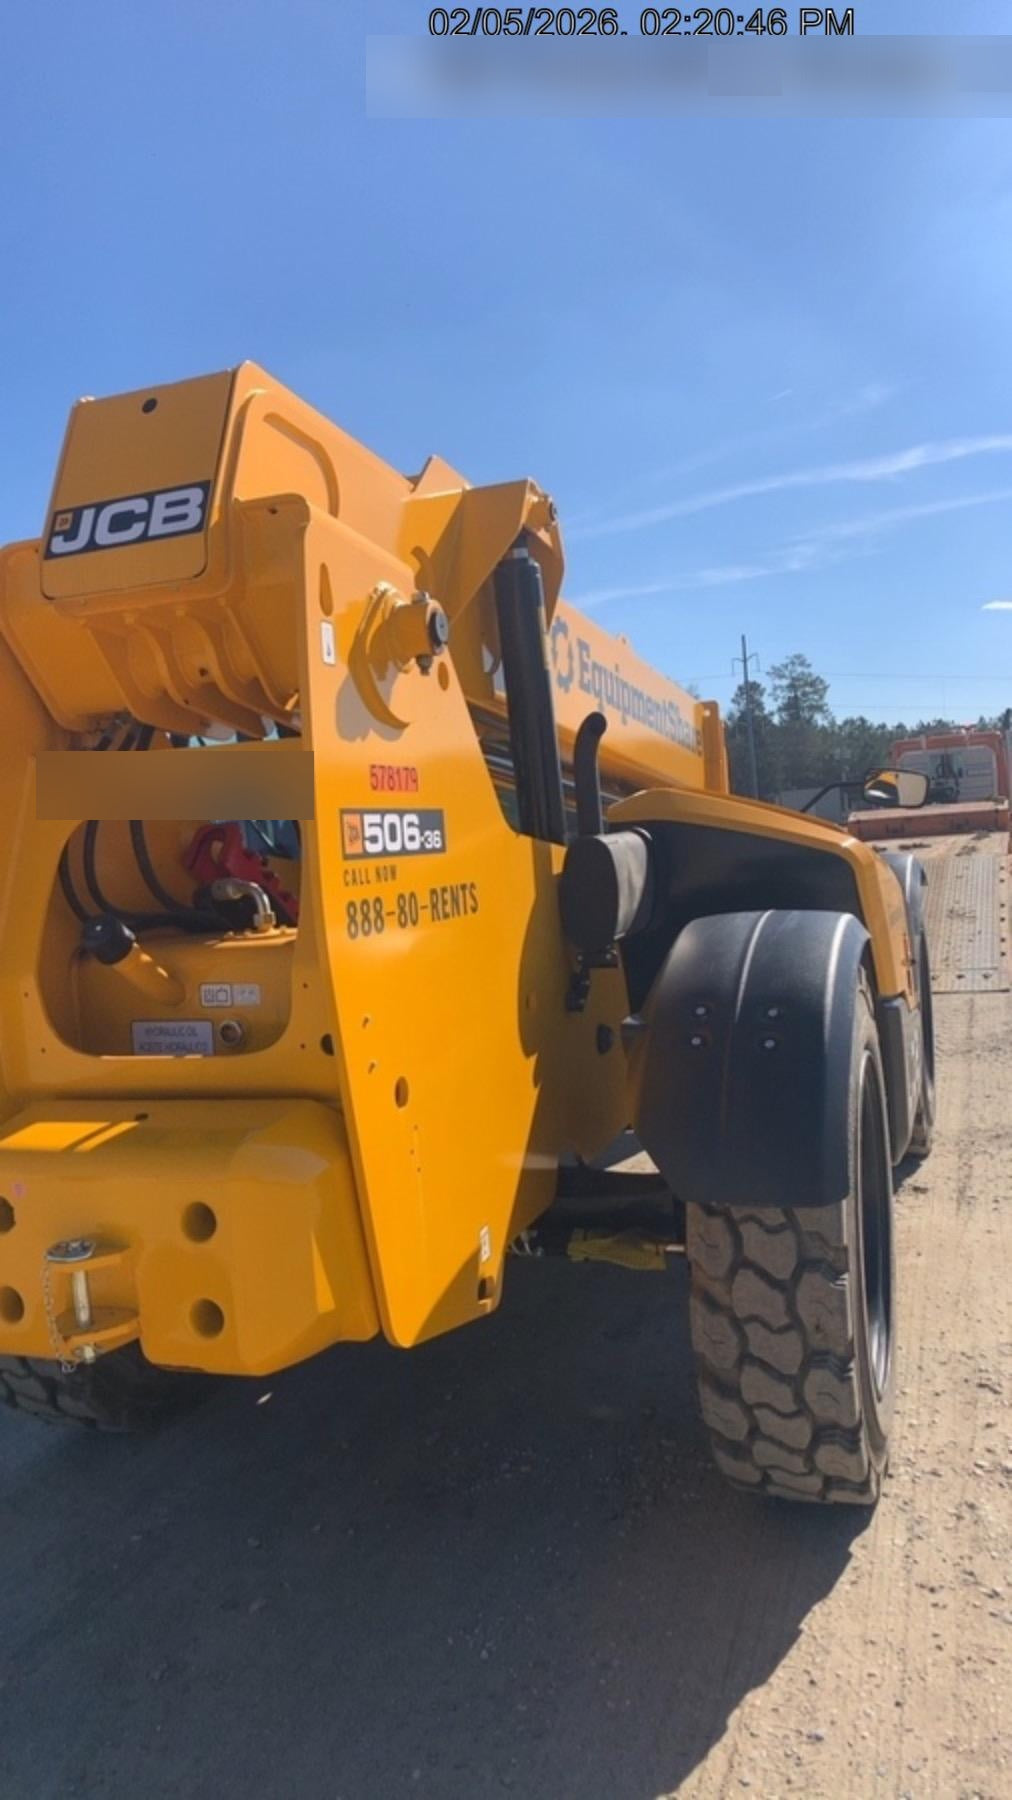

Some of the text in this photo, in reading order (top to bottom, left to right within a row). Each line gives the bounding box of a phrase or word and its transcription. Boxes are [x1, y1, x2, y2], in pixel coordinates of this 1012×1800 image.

[50, 487, 205, 554] JCB
[369, 764, 419, 792] 578179
[343, 864, 398, 887] CALL NOW
[346, 881, 479, 940] 888-80-RENTS
